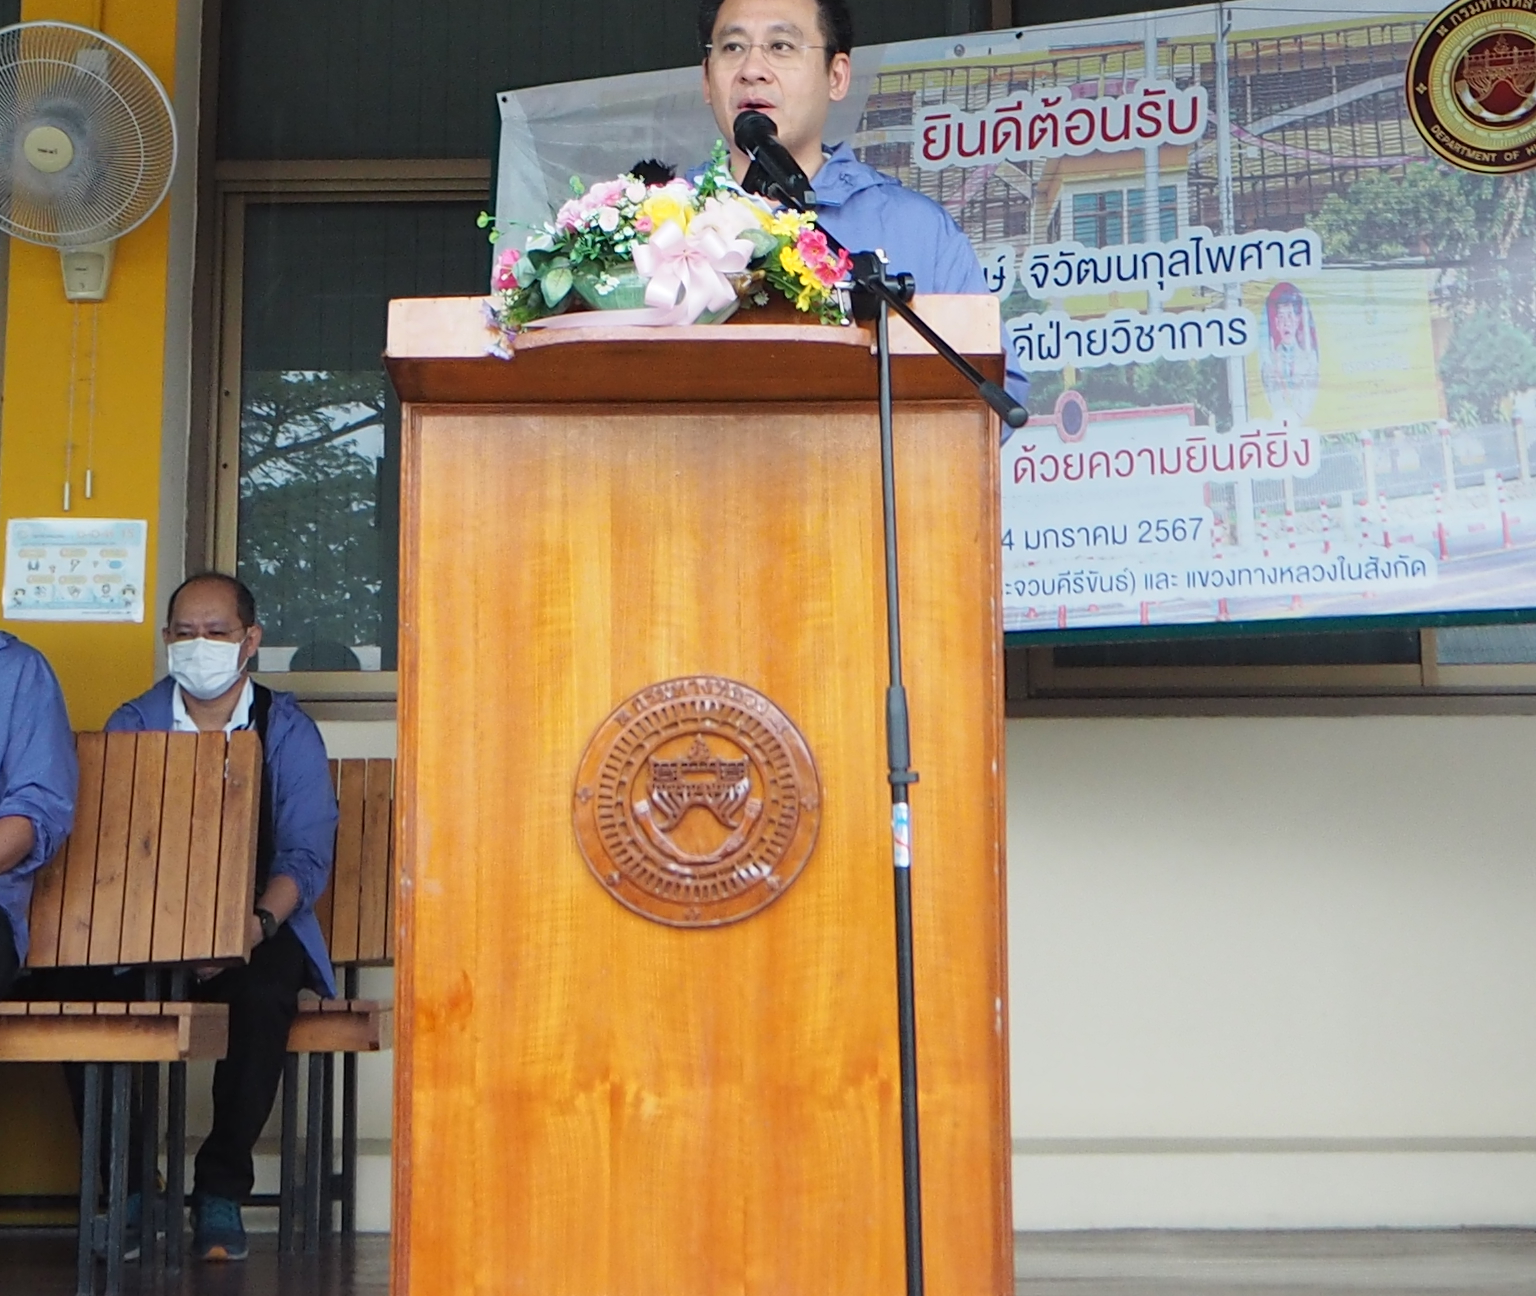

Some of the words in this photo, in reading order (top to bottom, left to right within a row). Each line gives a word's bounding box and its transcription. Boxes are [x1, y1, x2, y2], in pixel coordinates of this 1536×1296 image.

[922, 88, 1198, 161] ยินดีต้อนรับ
[1431, 124, 1498, 162] DEPARTMENT
[1504, 151, 1520, 162] OF
[1030, 236, 1312, 291] จิวัฒนกุลไพศาล
[1013, 420, 1311, 485] ด้วยความยินดียิ่ง
[1024, 524, 1128, 550] มกราคม
[1137, 516, 1204, 544] 2567
[1144, 571, 1178, 591] และ
[1186, 554, 1427, 589] แขวงทางหลวงในสังกัด
